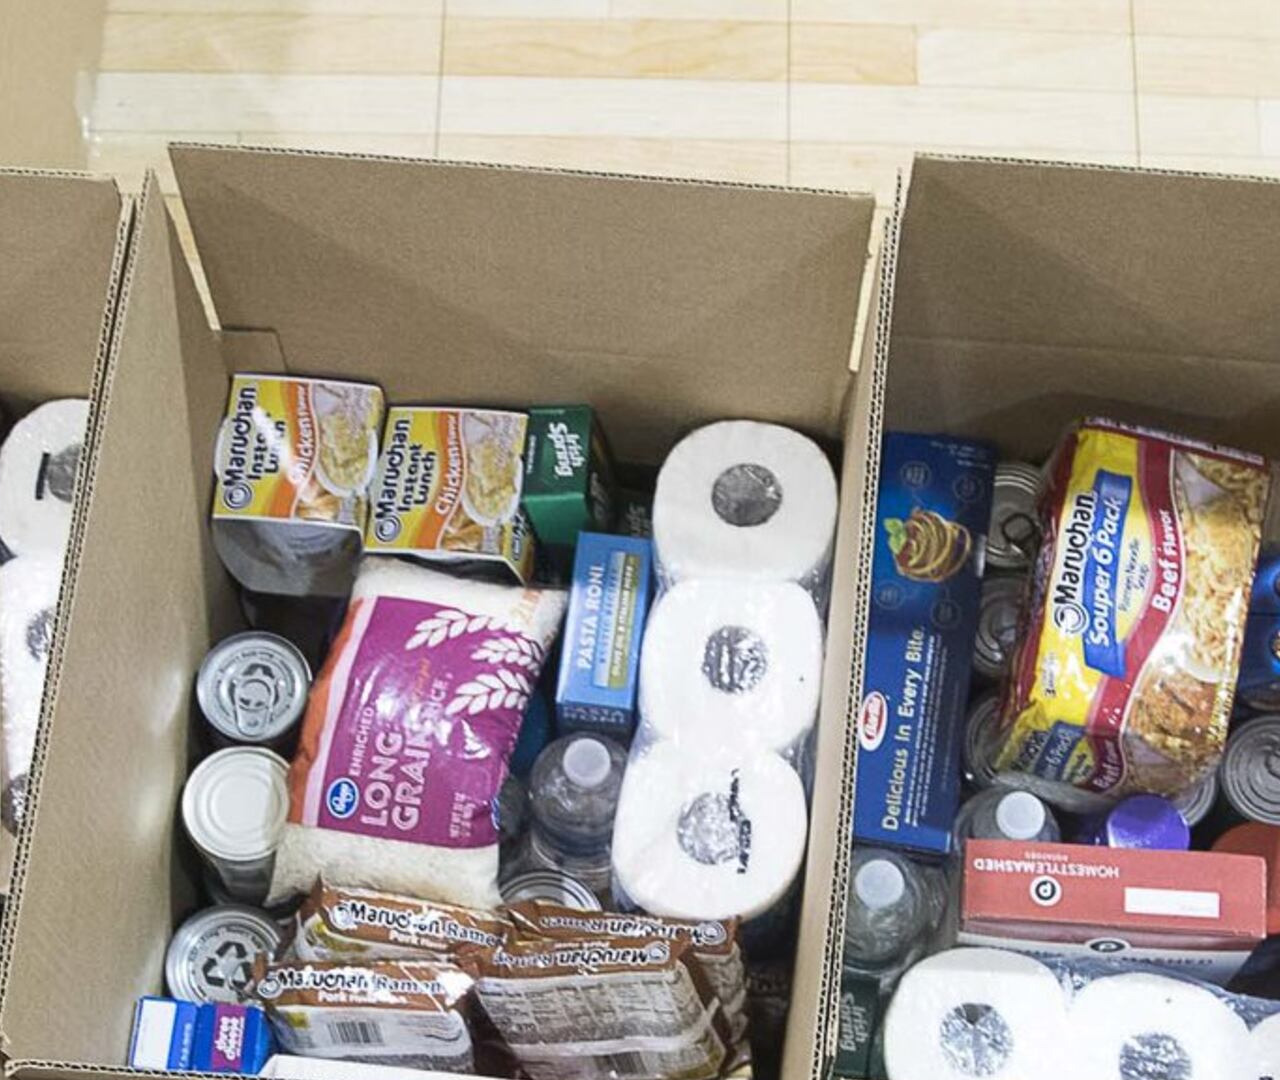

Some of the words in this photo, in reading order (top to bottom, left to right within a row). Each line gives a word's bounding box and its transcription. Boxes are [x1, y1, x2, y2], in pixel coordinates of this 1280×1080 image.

[223, 387, 257, 487] Maruchan
[548, 422, 574, 477] Spring
[375, 419, 410, 519] Maruchan
[398, 444, 422, 512] Instant
[414, 451, 436, 505] Lunch
[435, 453, 461, 515] Chicken
[1054, 494, 1094, 604] Maruchan
[1098, 496, 1125, 545] Pack
[1159, 509, 1178, 557] Flavor
[1093, 545, 1113, 562] 6
[1090, 562, 1114, 647] Souper
[1152, 558, 1180, 613] Beef
[577, 616, 599, 670] PASTA
[898, 669, 923, 717] Every
[349, 707, 375, 777] ENRICHED
[894, 723, 912, 742] In
[360, 731, 403, 826] LONG
[881, 748, 909, 831] Delicious
[557, 948, 649, 966] Maruchan
[840, 992, 857, 1052] Spring
